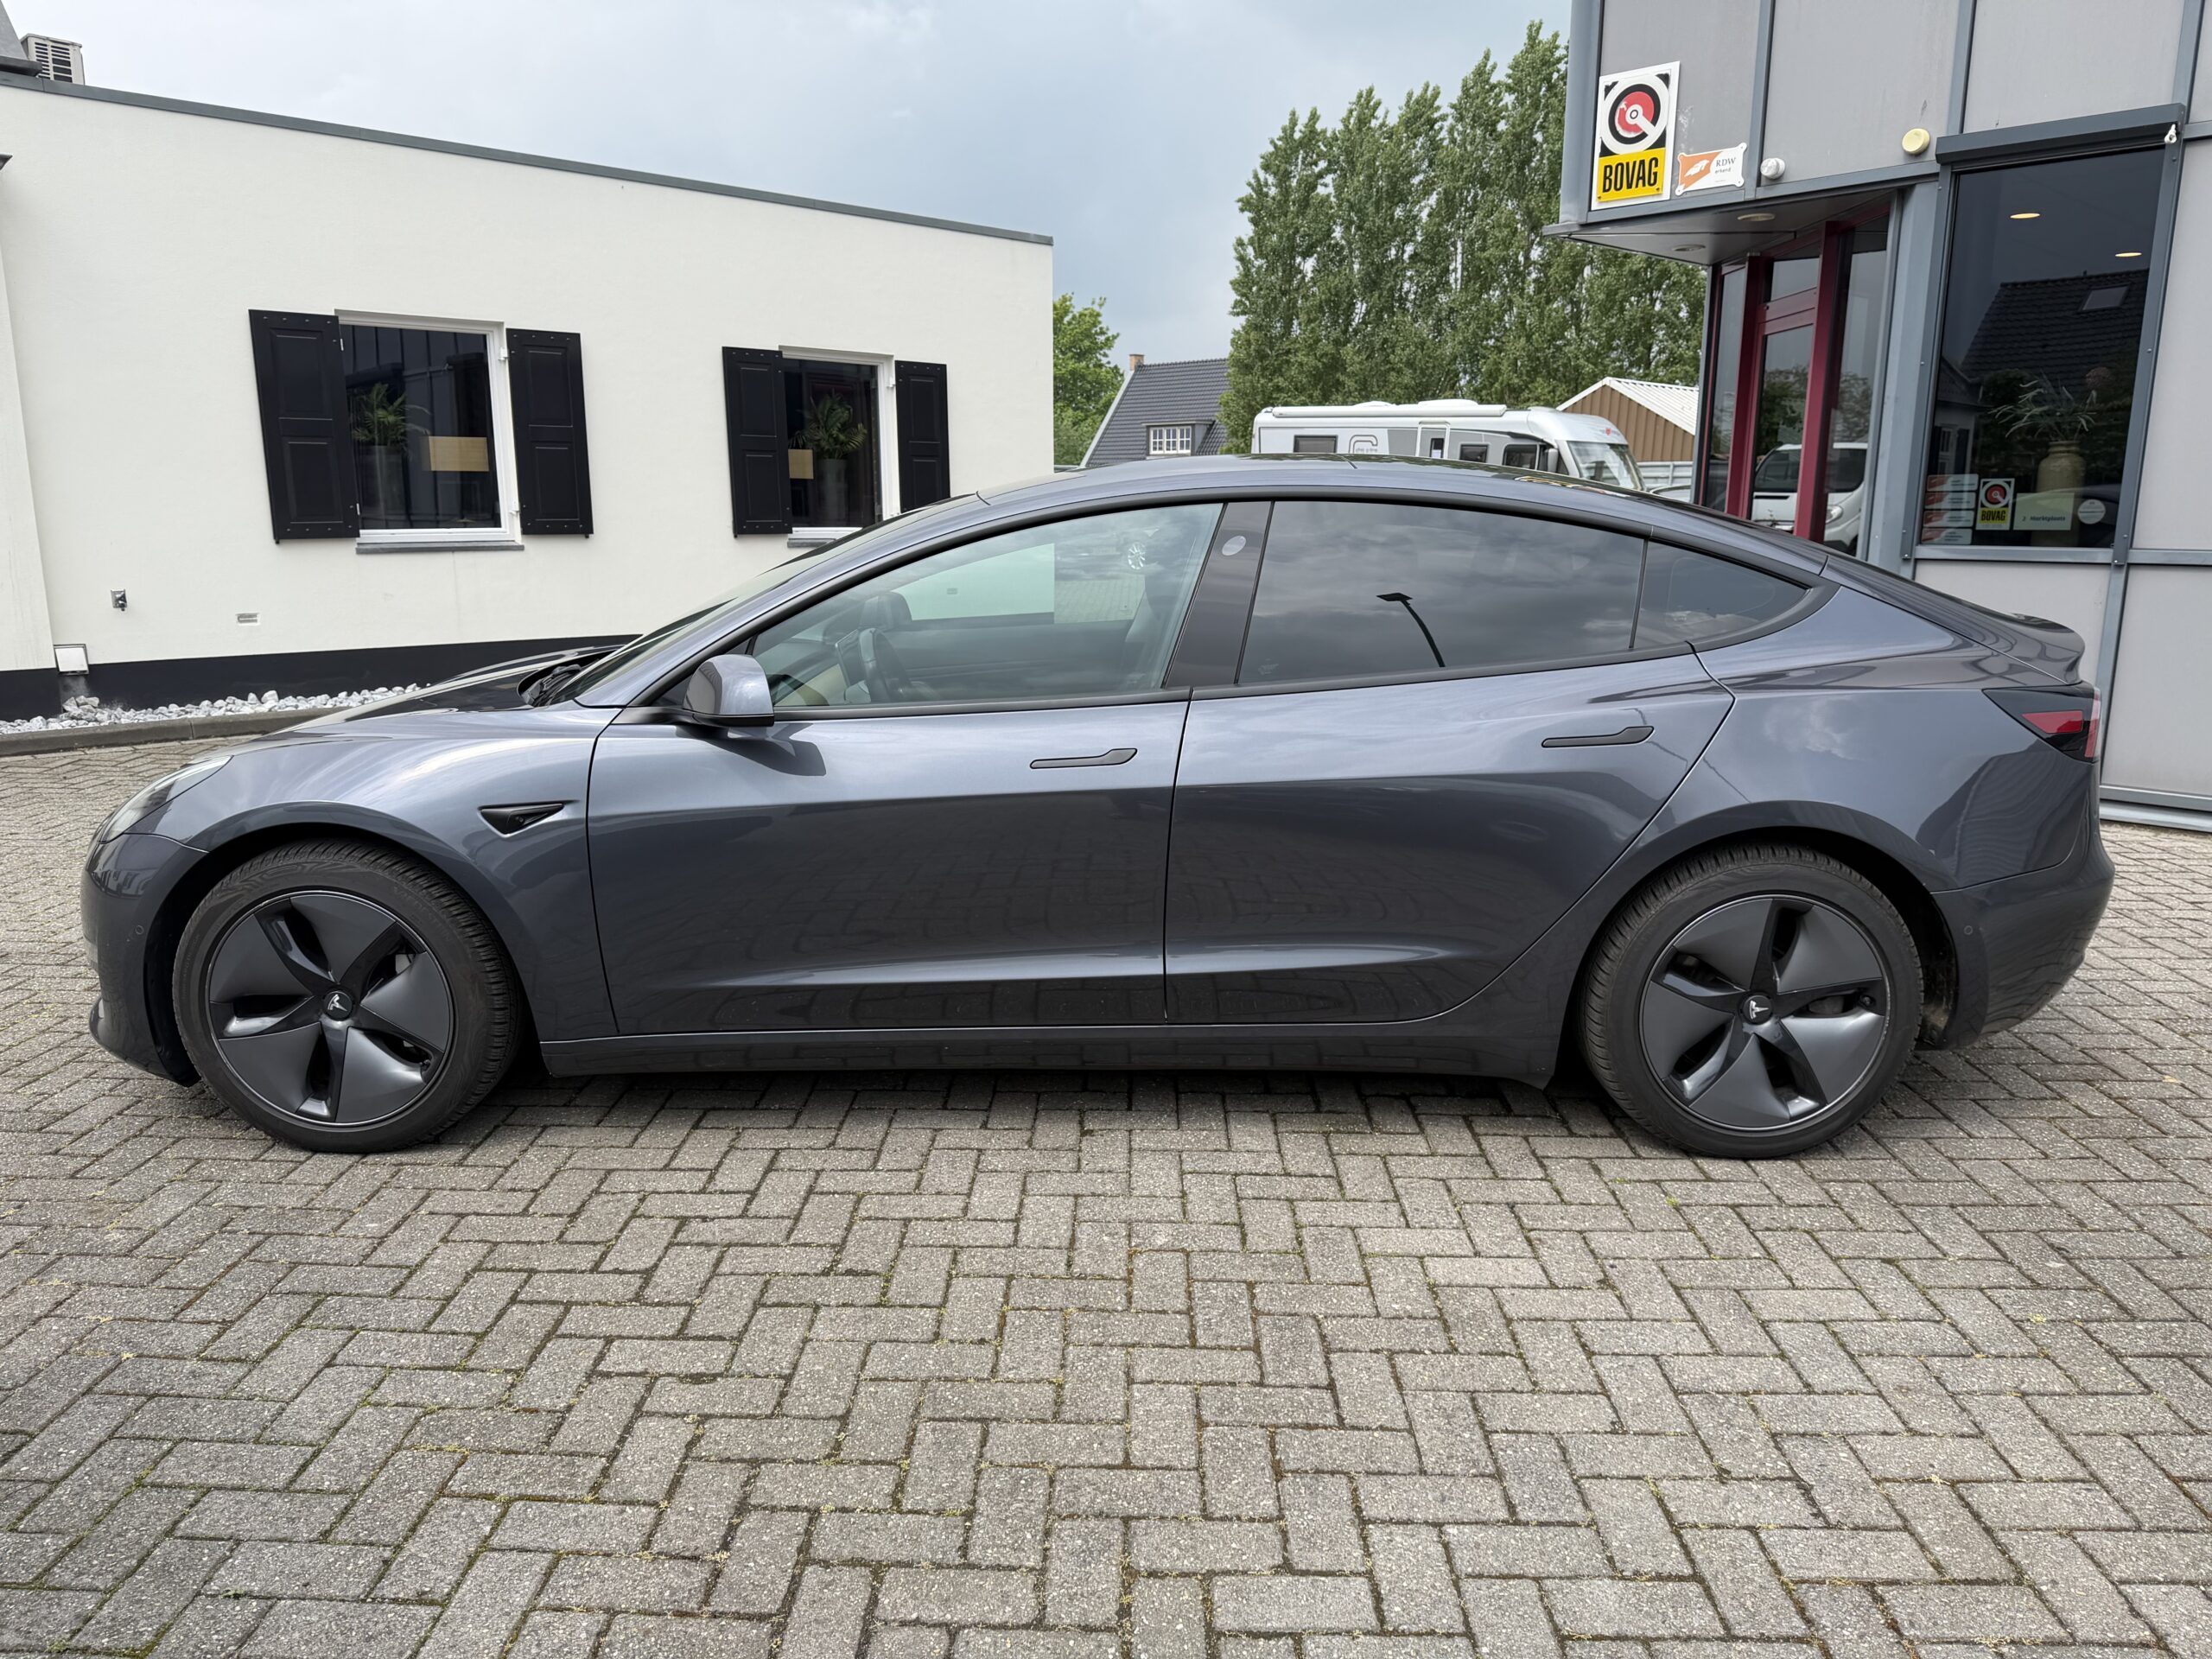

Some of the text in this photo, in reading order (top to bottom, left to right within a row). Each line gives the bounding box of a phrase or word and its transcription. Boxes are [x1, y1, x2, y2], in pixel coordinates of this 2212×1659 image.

[1715, 157, 1736, 168] RDW
[1602, 156, 1658, 193] BOVAG
[1981, 510, 2006, 521] BOVAG
